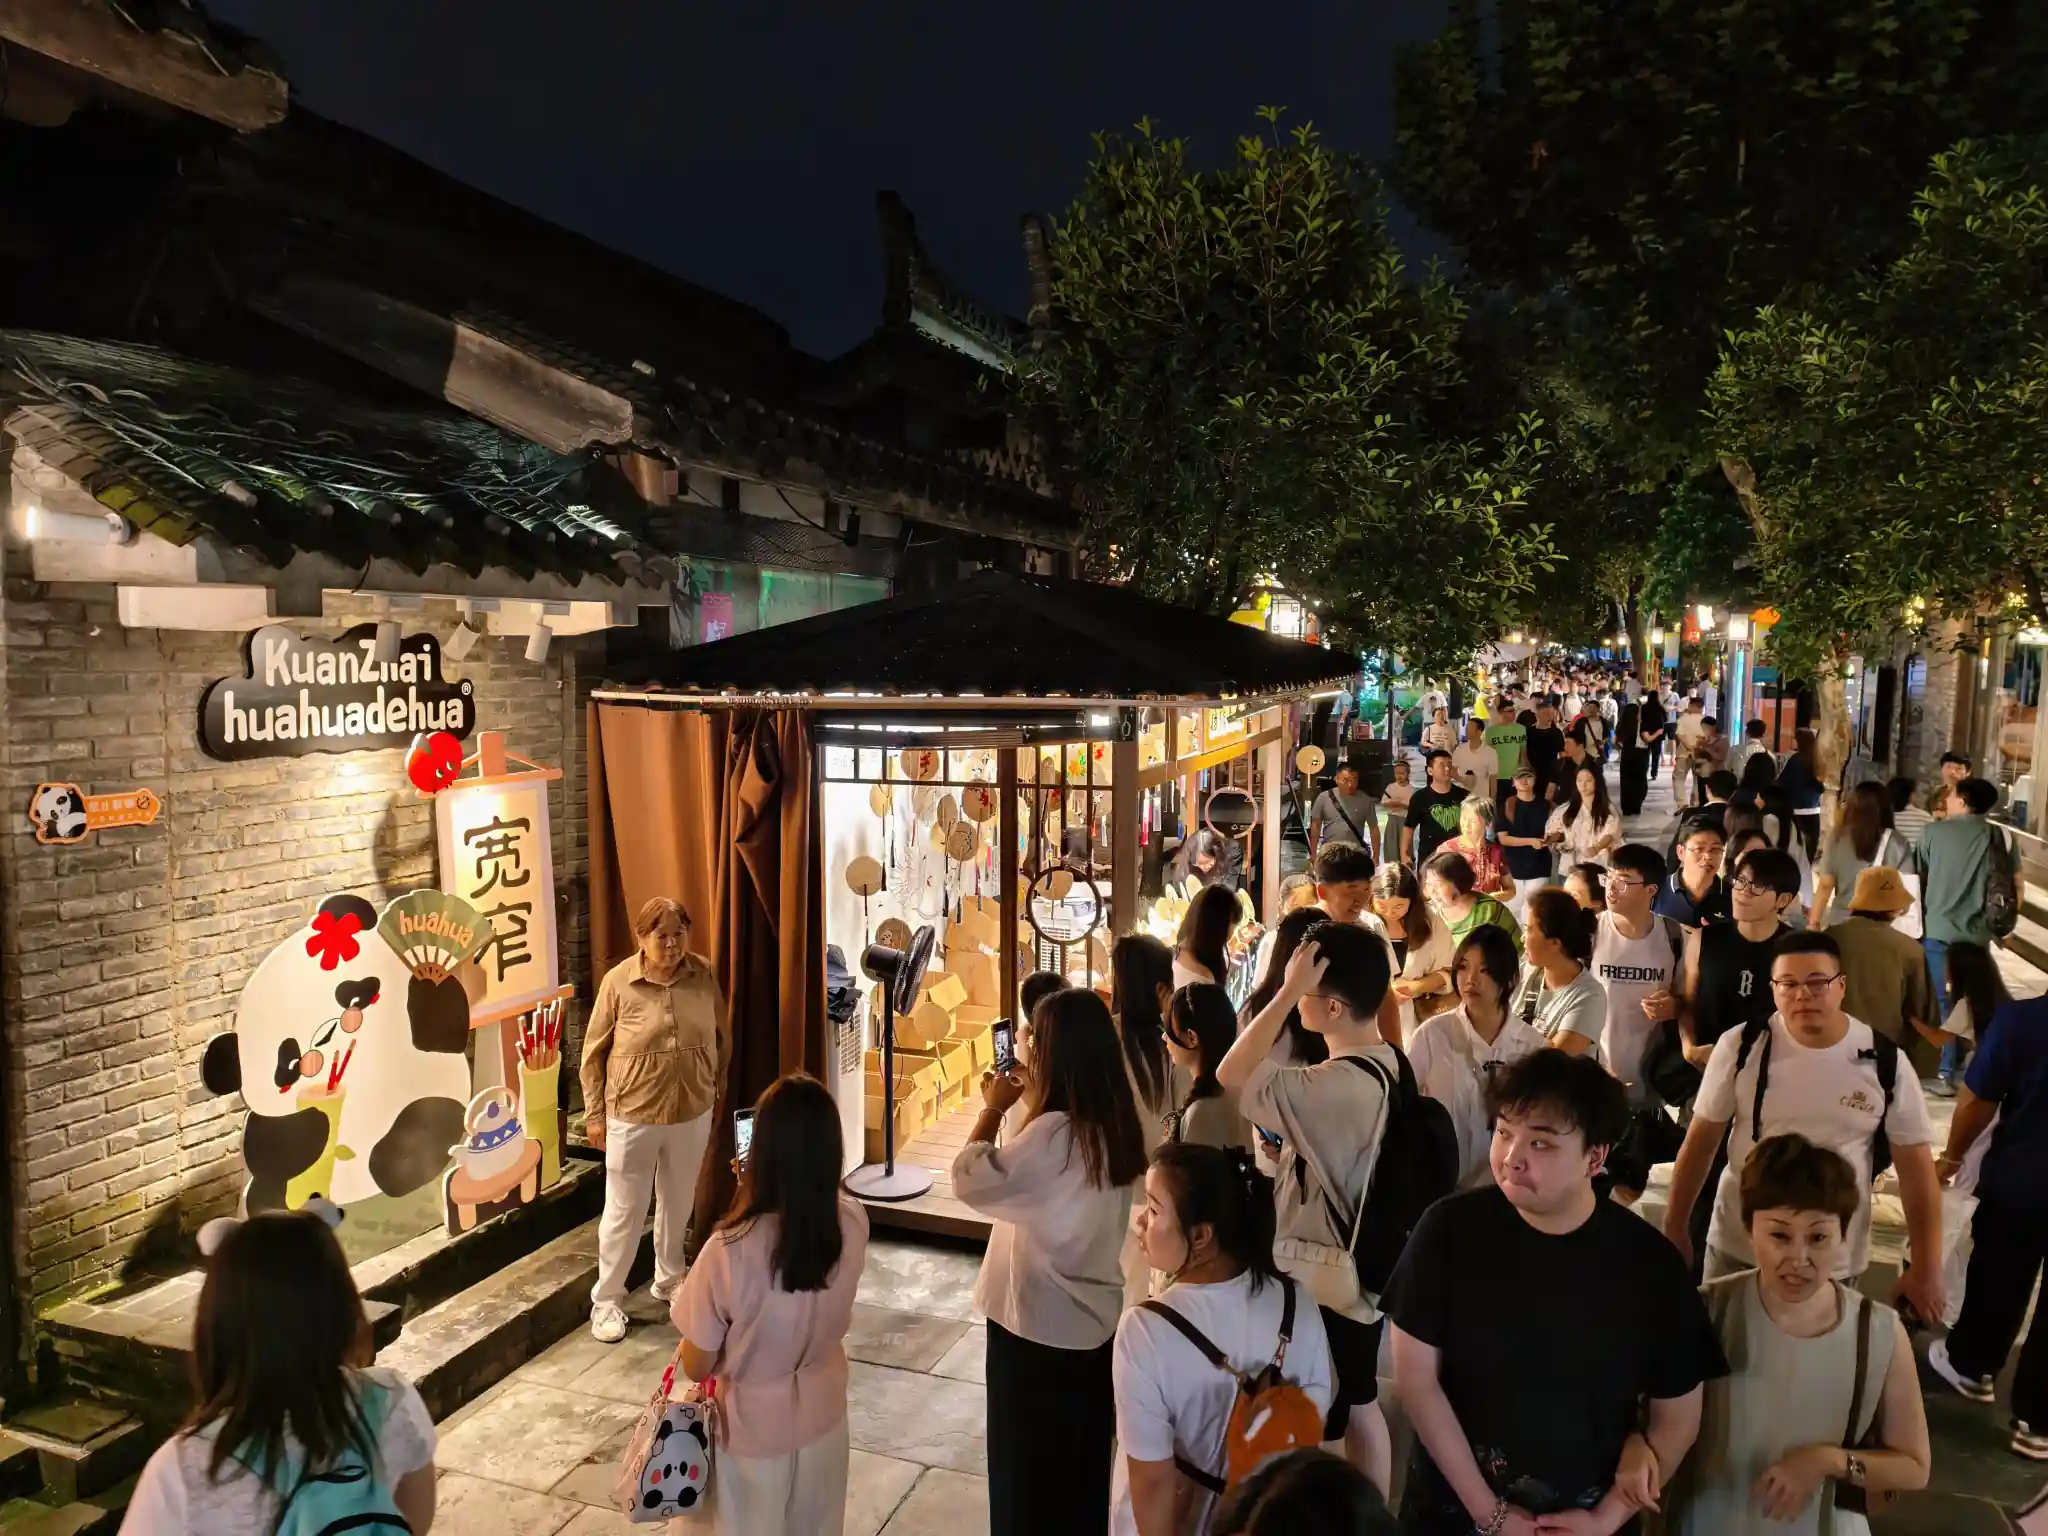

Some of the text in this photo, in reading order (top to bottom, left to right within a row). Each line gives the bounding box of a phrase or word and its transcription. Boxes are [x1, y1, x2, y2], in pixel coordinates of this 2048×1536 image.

[223, 685, 464, 743] huahuadehua
[400, 910, 474, 949] huahua
[1599, 964, 1665, 982] FREEDOM
